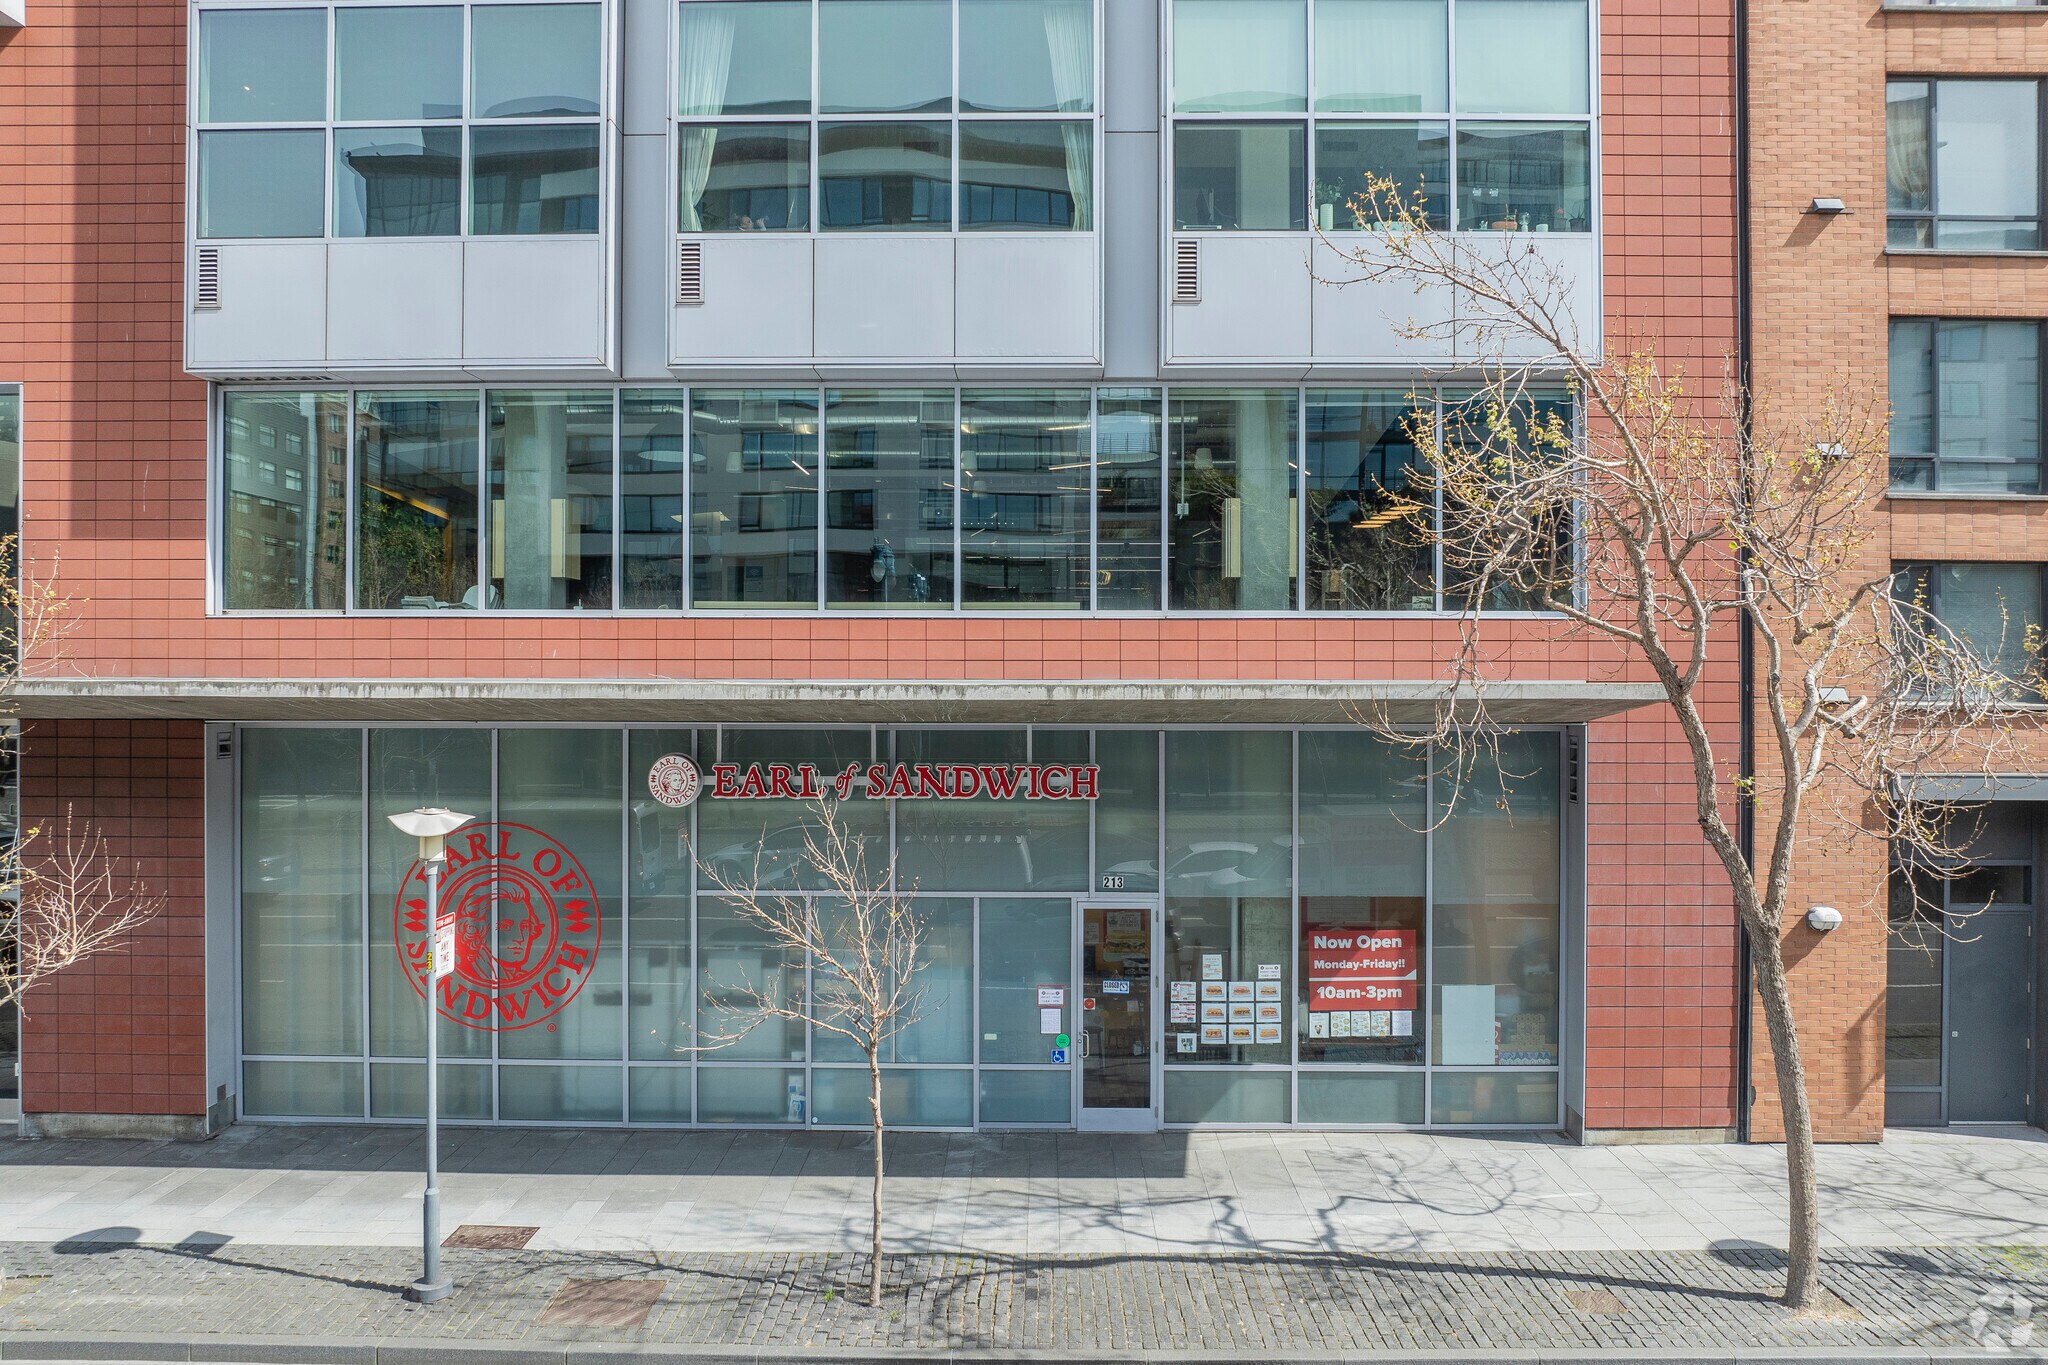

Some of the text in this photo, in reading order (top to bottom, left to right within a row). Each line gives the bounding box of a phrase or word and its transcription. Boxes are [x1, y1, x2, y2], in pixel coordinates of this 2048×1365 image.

[653, 757, 694, 773] EARL OF
[712, 763, 1100, 799] EARL of SANDWICH
[651, 784, 696, 804] SANDWICH
[533, 848, 583, 892] OF
[1103, 876, 1123, 888] 213
[1314, 935, 1402, 951] Now Open
[1314, 959, 1405, 971] Monday-Friday!!
[1104, 981, 1120, 989] CLOSED
[1317, 985, 1402, 1001] 10am-3pm
